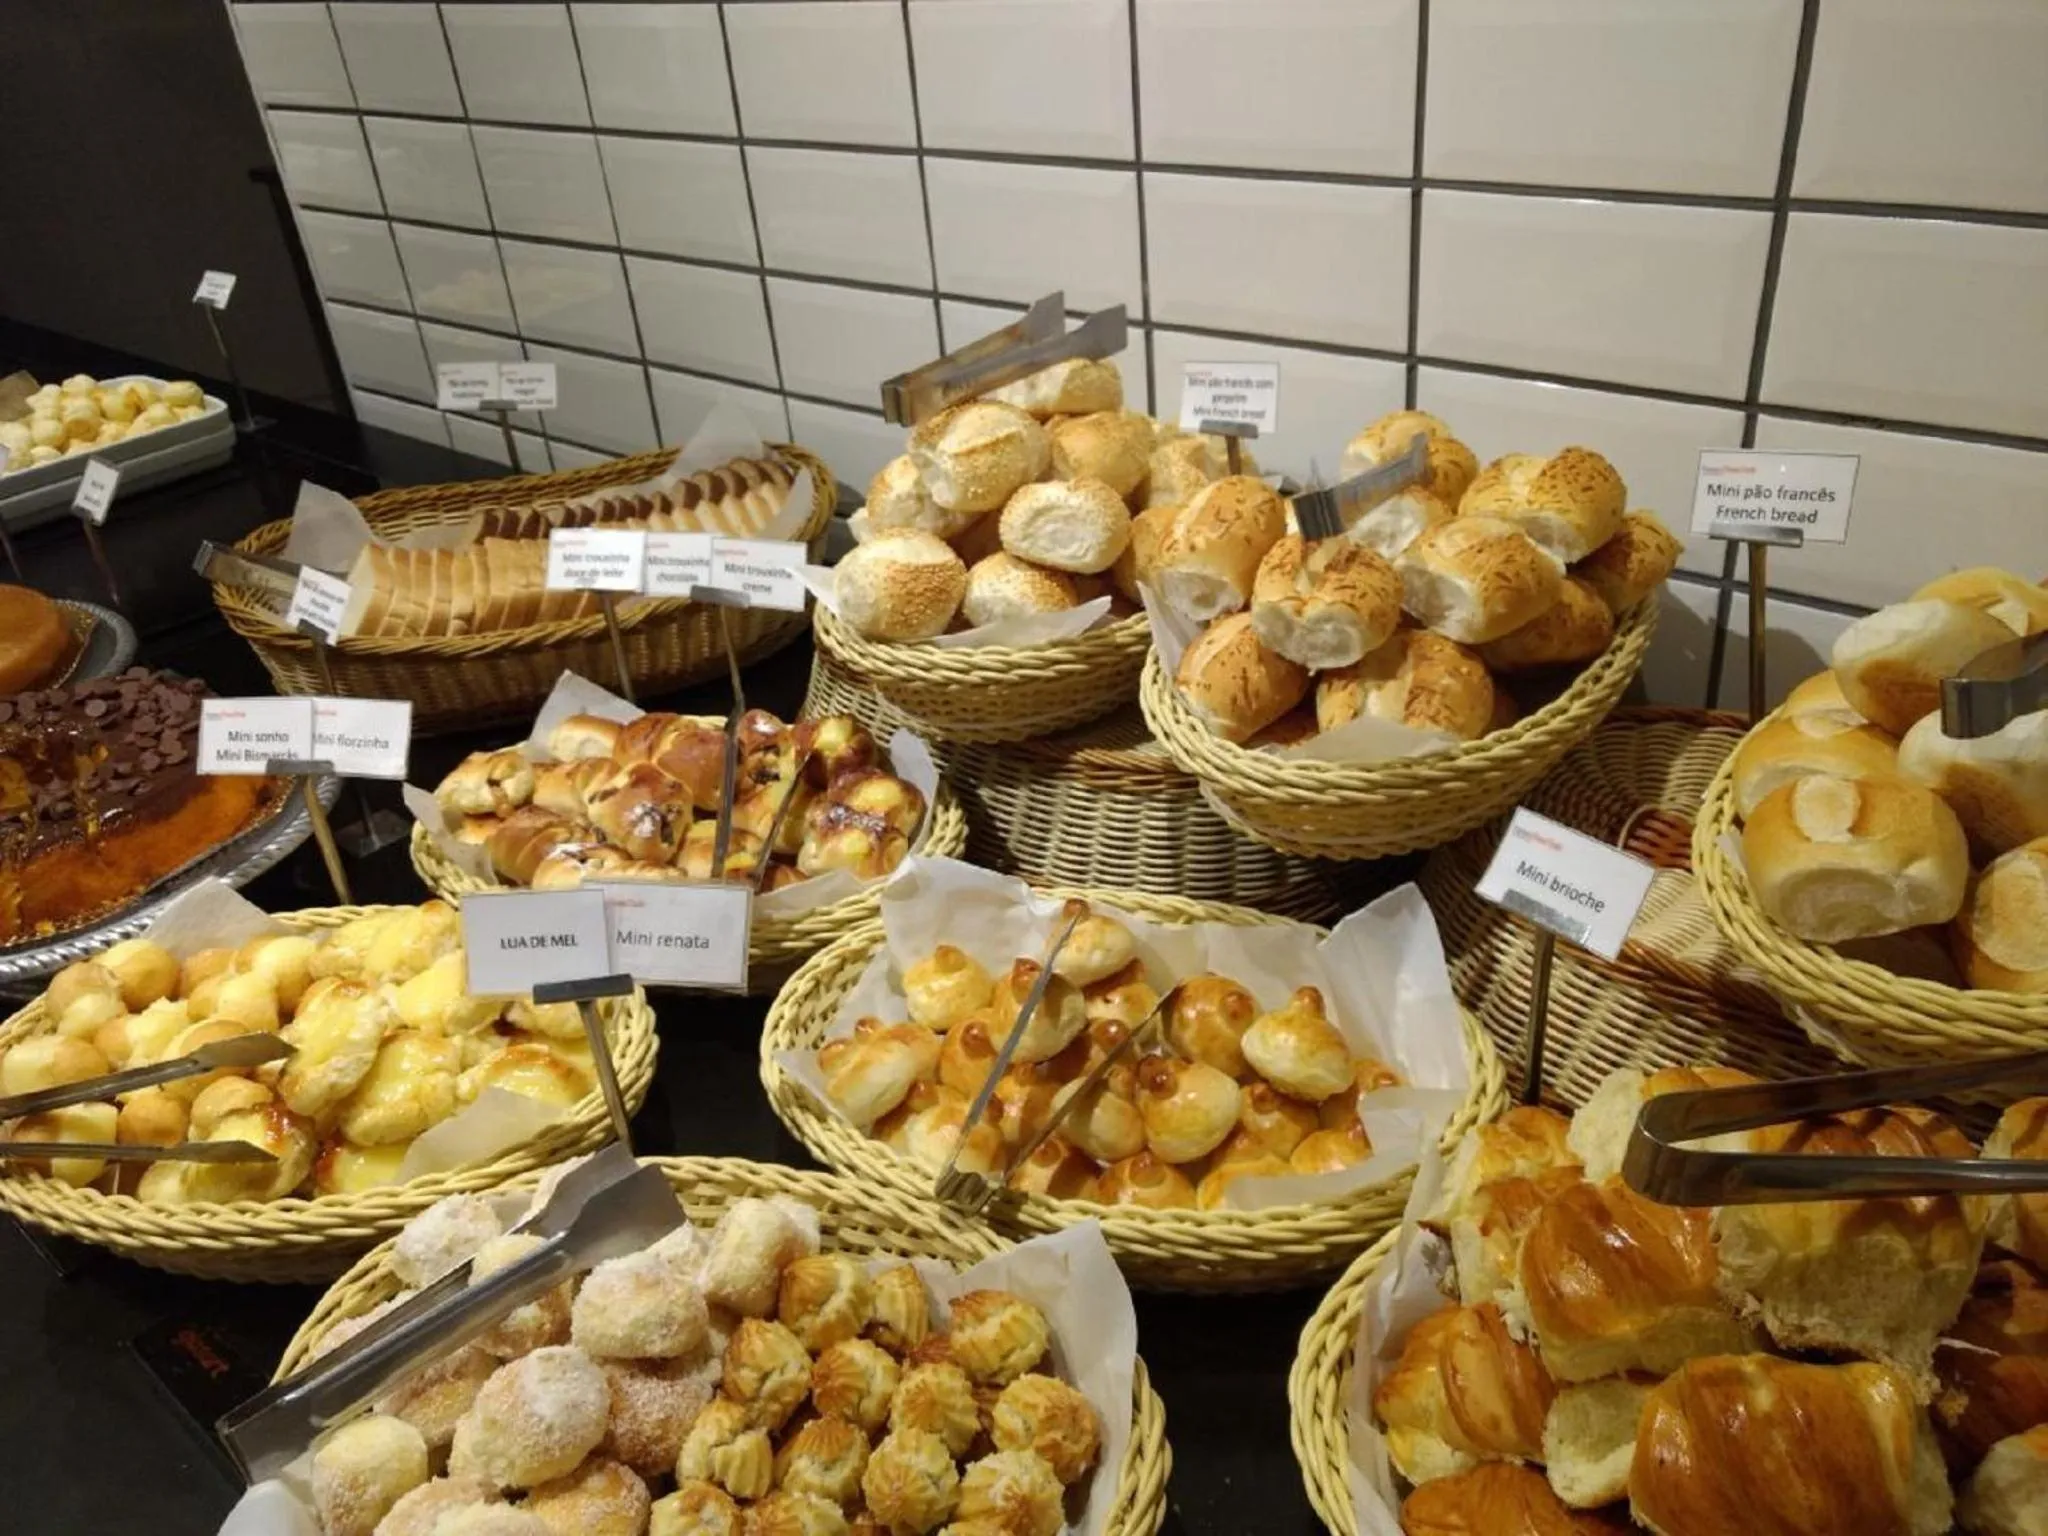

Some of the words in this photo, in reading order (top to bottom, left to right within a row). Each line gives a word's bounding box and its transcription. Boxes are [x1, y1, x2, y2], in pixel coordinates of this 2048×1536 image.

[1706, 484, 1740, 498] Mini
[1744, 484, 1772, 501] pão
[1777, 485, 1836, 502] francês
[1716, 505, 1767, 521] French
[1771, 507, 1819, 523] bread
[724, 561, 745, 574] Mini
[228, 730, 252, 743] Mini
[255, 730, 289, 743] sonho
[337, 735, 389, 749] florzinha
[216, 749, 241, 761] Mini
[1516, 860, 1550, 886] Mini
[1550, 874, 1605, 912] brioche
[500, 936, 527, 950] LUA
[530, 935, 548, 949] DE
[550, 933, 578, 948] MEL
[616, 930, 651, 946] Mini
[657, 933, 710, 949] renata
